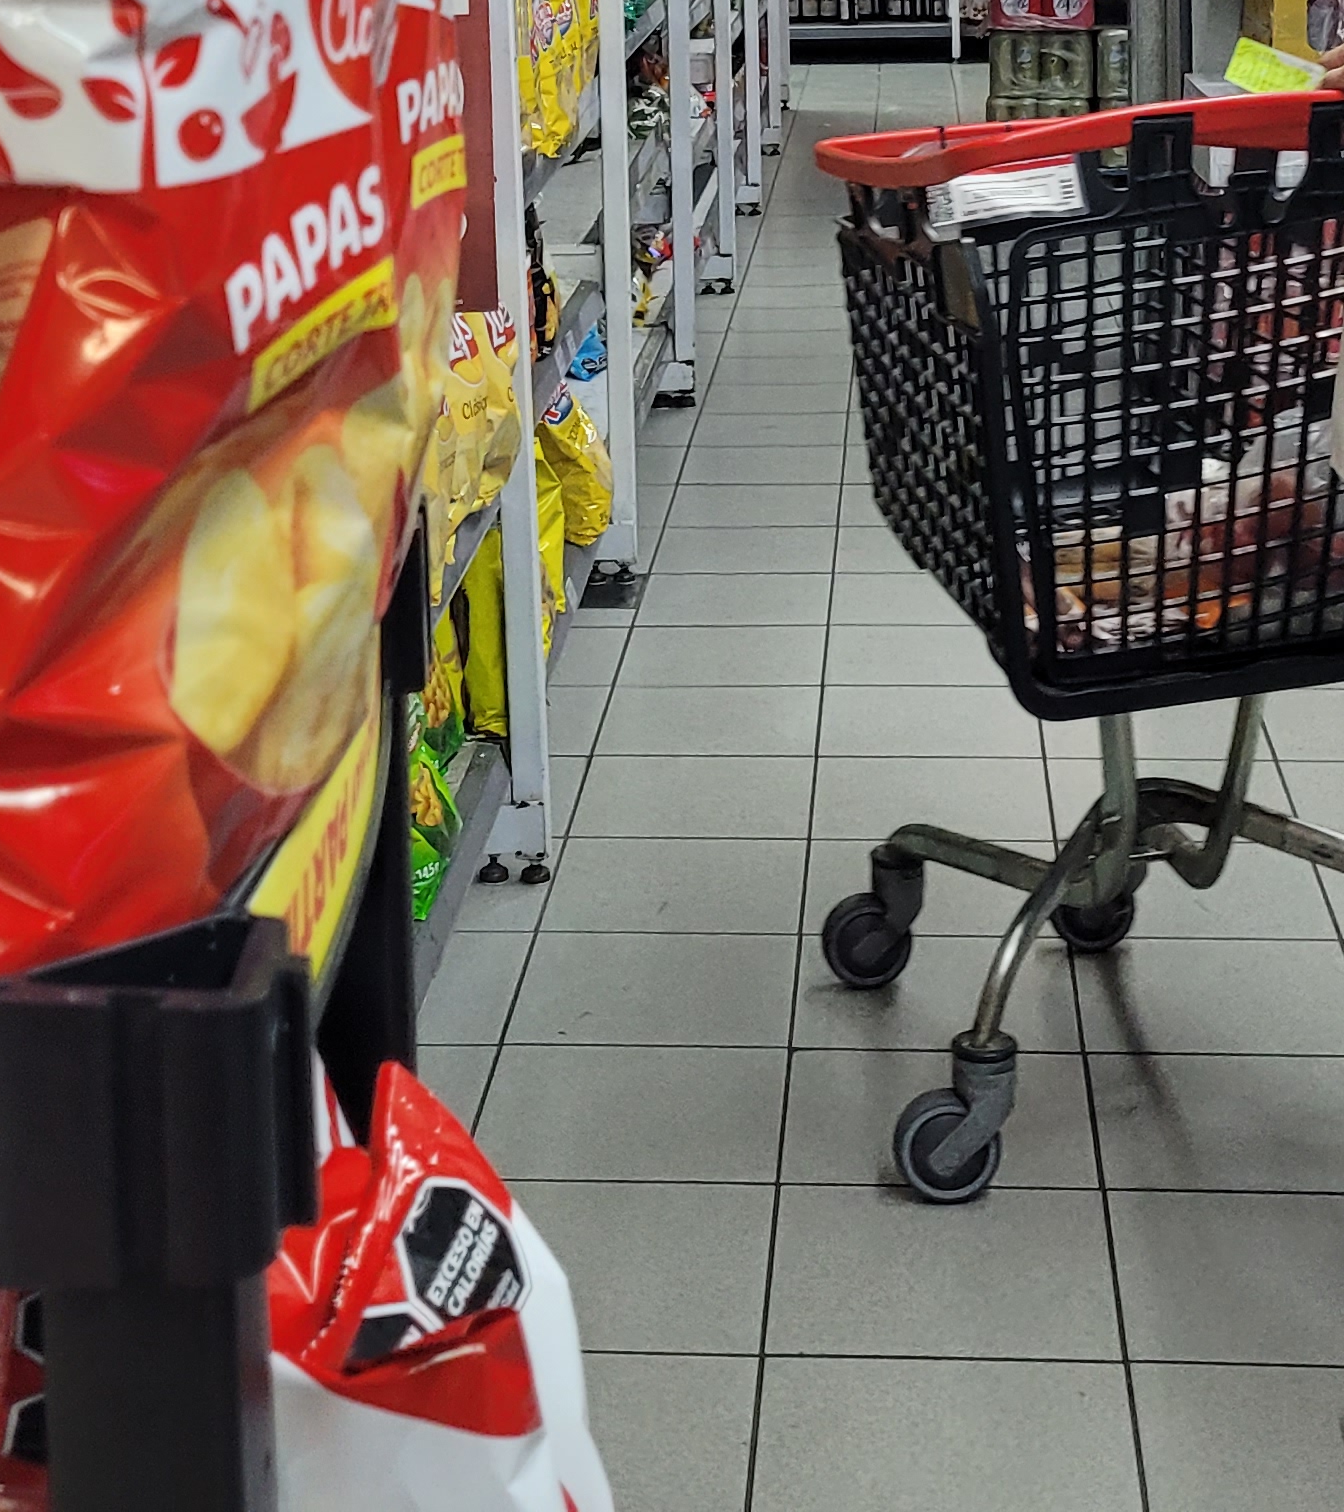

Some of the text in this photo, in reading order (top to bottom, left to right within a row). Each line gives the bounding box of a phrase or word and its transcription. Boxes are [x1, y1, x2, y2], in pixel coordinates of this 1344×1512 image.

[226, 165, 386, 356] PAPAS
[425, 1225, 474, 1308] EXCESO
[446, 1218, 499, 1317] CALORÍAS
